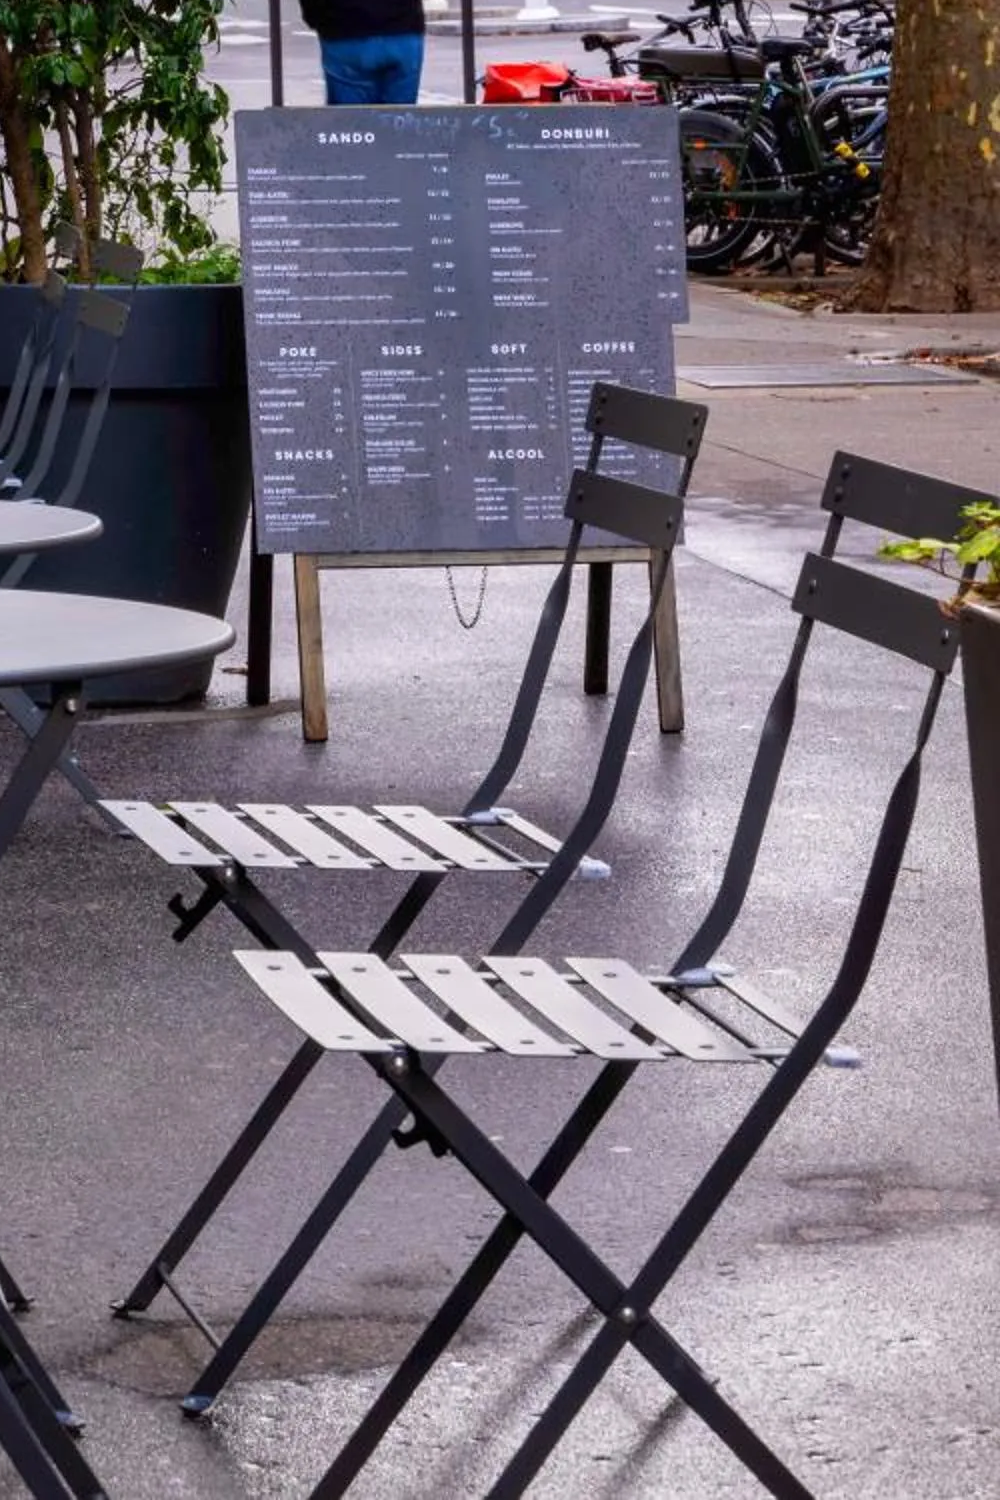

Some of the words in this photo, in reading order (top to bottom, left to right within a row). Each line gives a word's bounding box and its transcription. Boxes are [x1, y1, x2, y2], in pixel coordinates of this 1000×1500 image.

[318, 131, 375, 144] SANDO
[541, 127, 610, 139] DONBURI
[279, 347, 317, 357] POKE
[381, 345, 423, 356] SIDES
[491, 343, 527, 355] SOFT
[582, 341, 636, 353] COFFEE
[275, 449, 334, 461] SNACKS
[487, 448, 545, 460] ALCOOL
